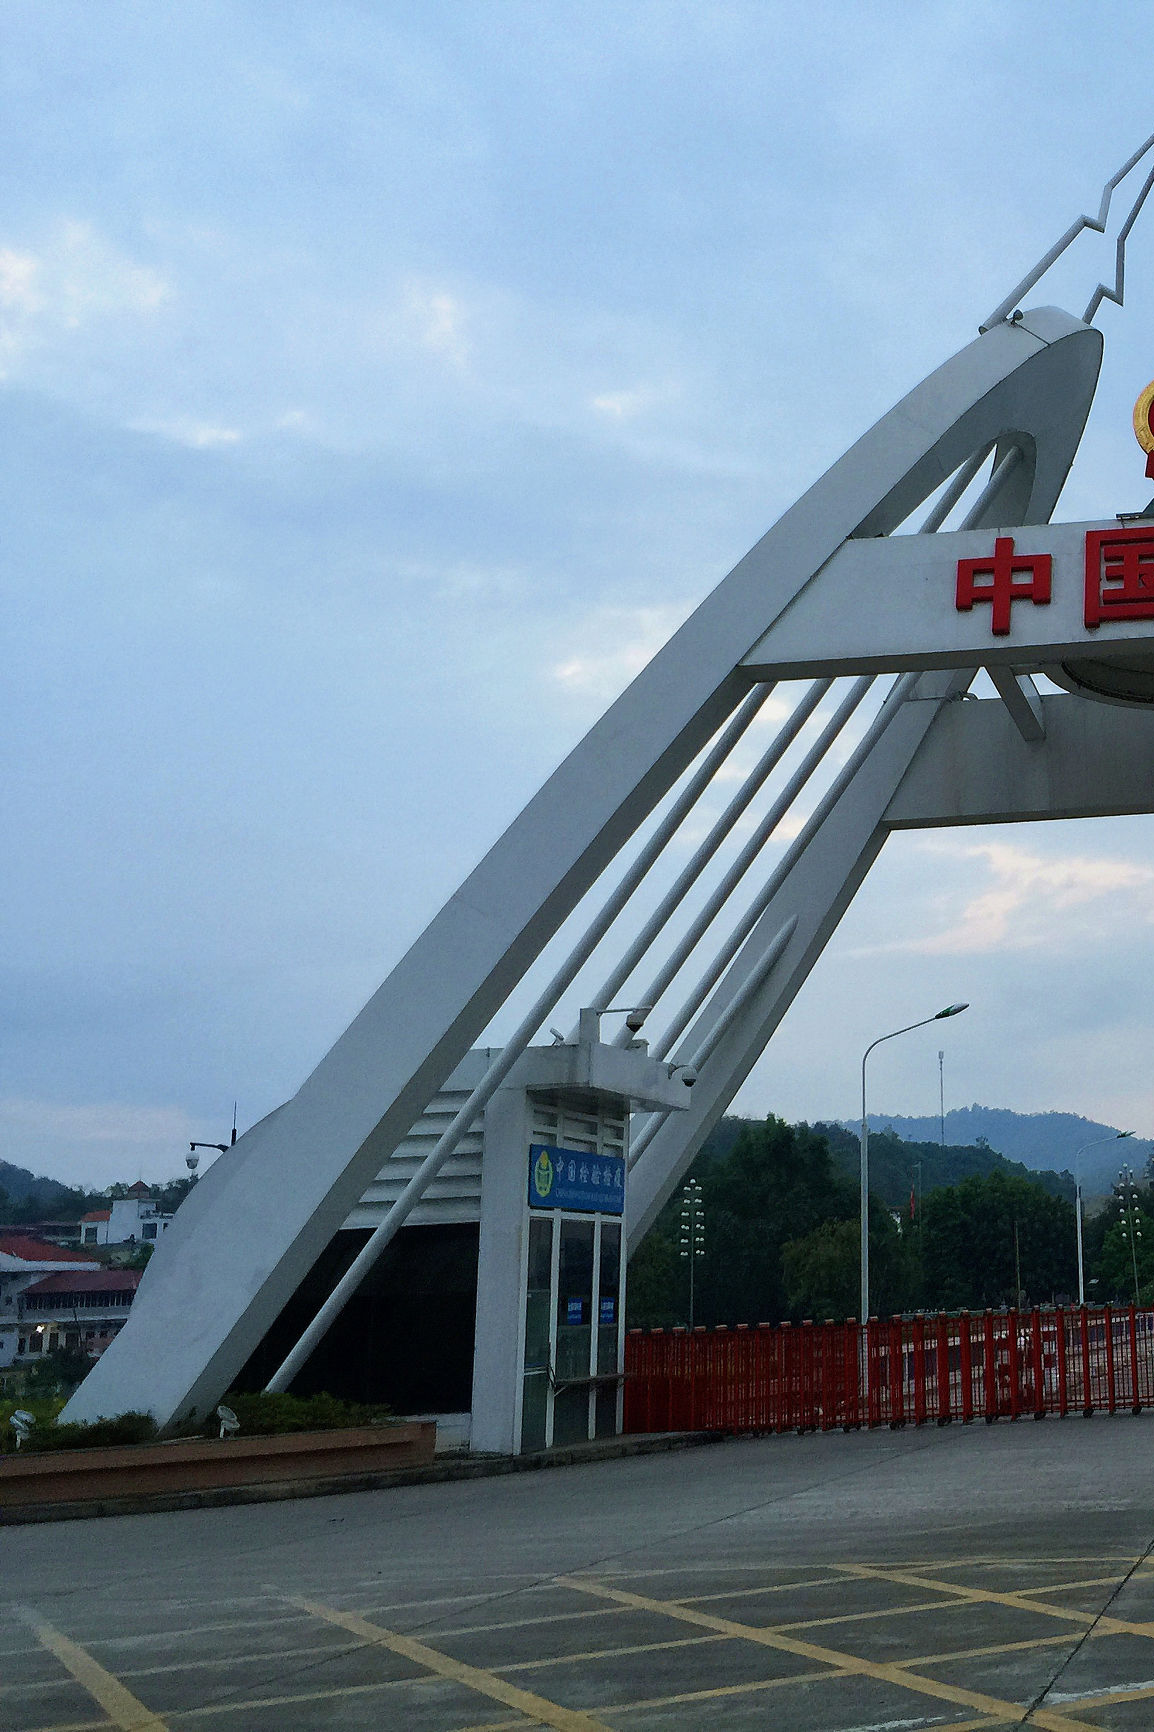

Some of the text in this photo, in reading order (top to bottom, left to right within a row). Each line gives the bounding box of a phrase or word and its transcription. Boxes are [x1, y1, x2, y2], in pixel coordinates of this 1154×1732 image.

[554, 1155, 623, 1189] 中国检验检疫
